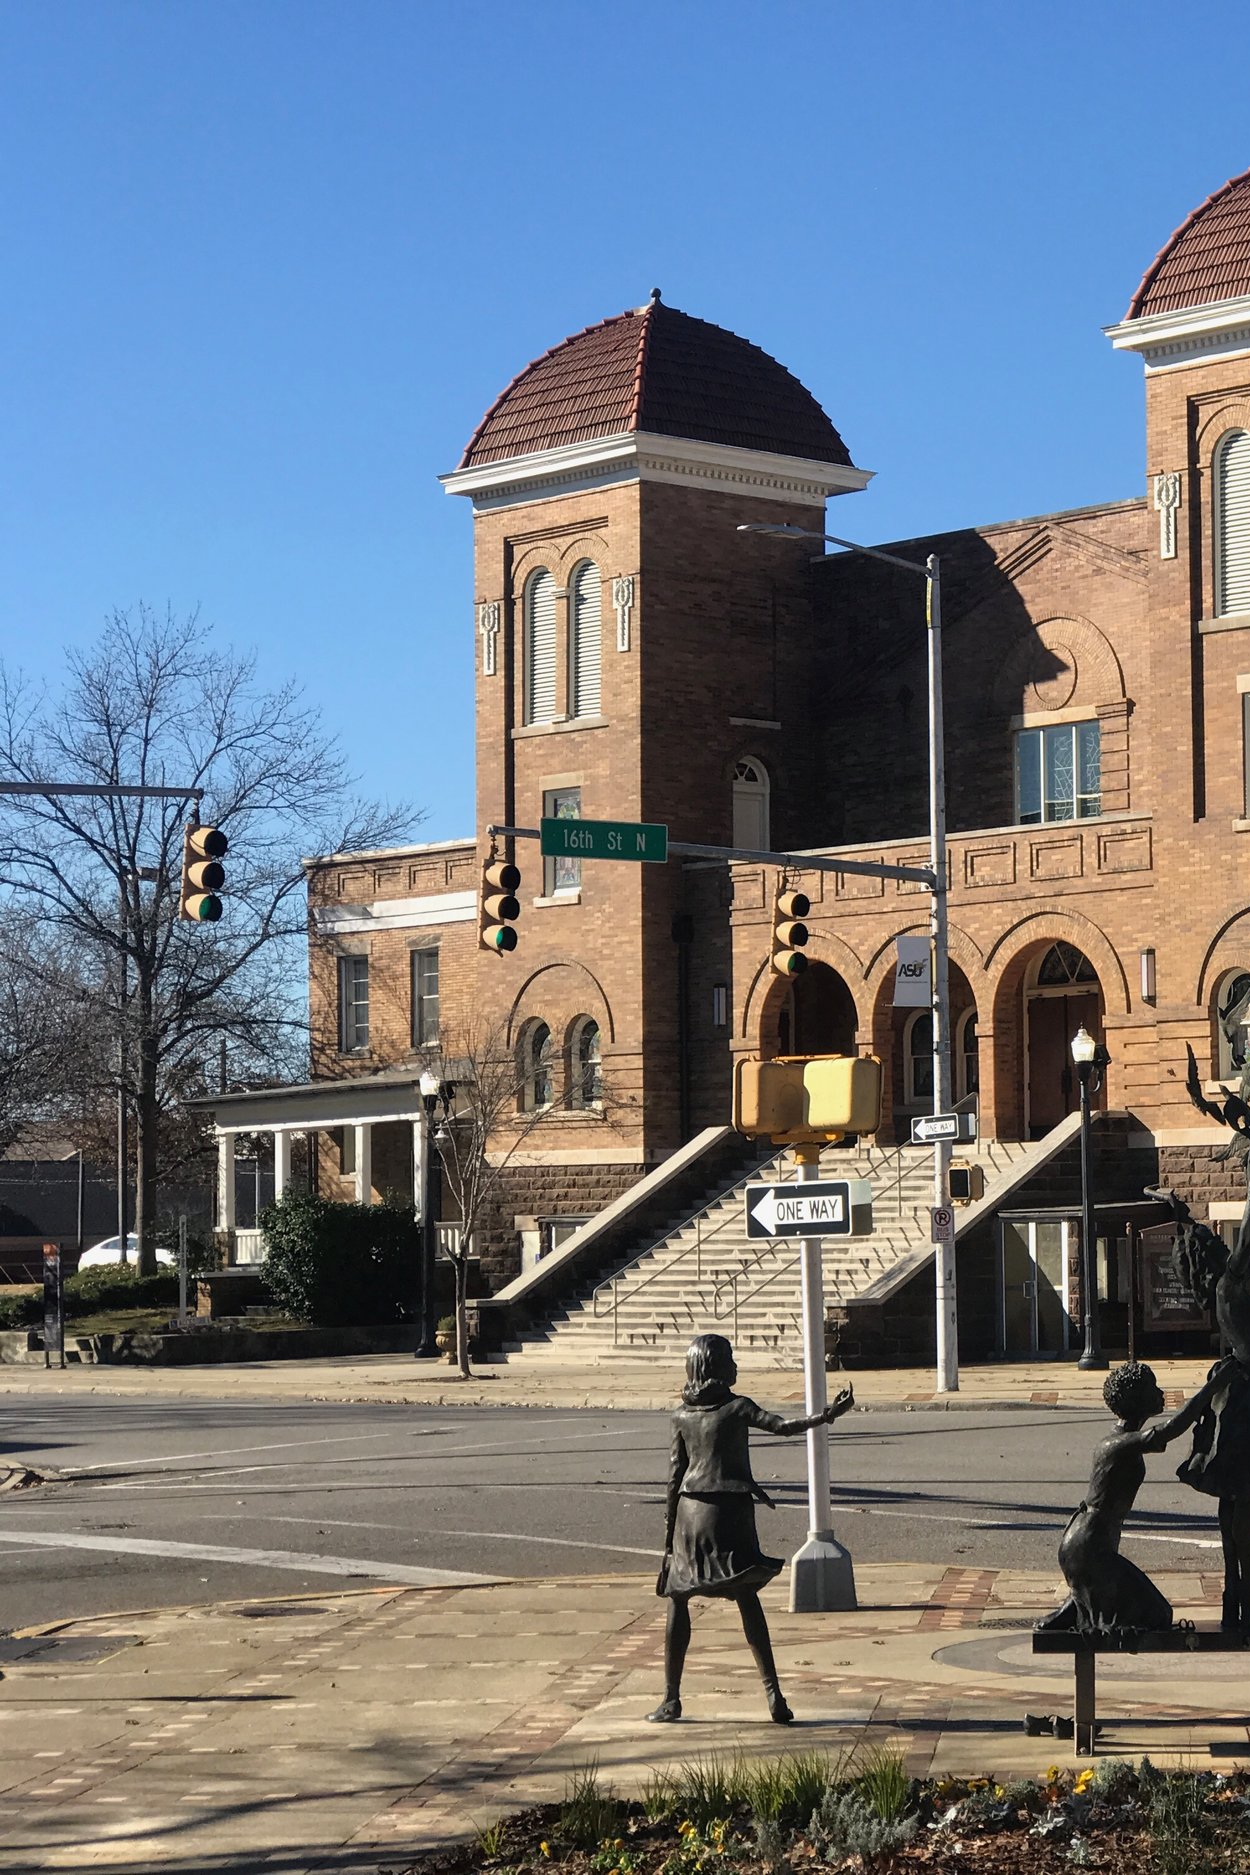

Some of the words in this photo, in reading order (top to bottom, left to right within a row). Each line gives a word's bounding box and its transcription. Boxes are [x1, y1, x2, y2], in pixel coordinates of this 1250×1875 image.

[563, 829, 593, 849] 16th
[607, 831, 623, 851] St
[636, 833, 646, 852] N
[898, 963, 923, 977] ASU
[925, 1122, 938, 1134] ONE
[940, 1121, 953, 1132] WAY
[776, 1201, 804, 1221] ONE
[809, 1199, 838, 1219] WAY
